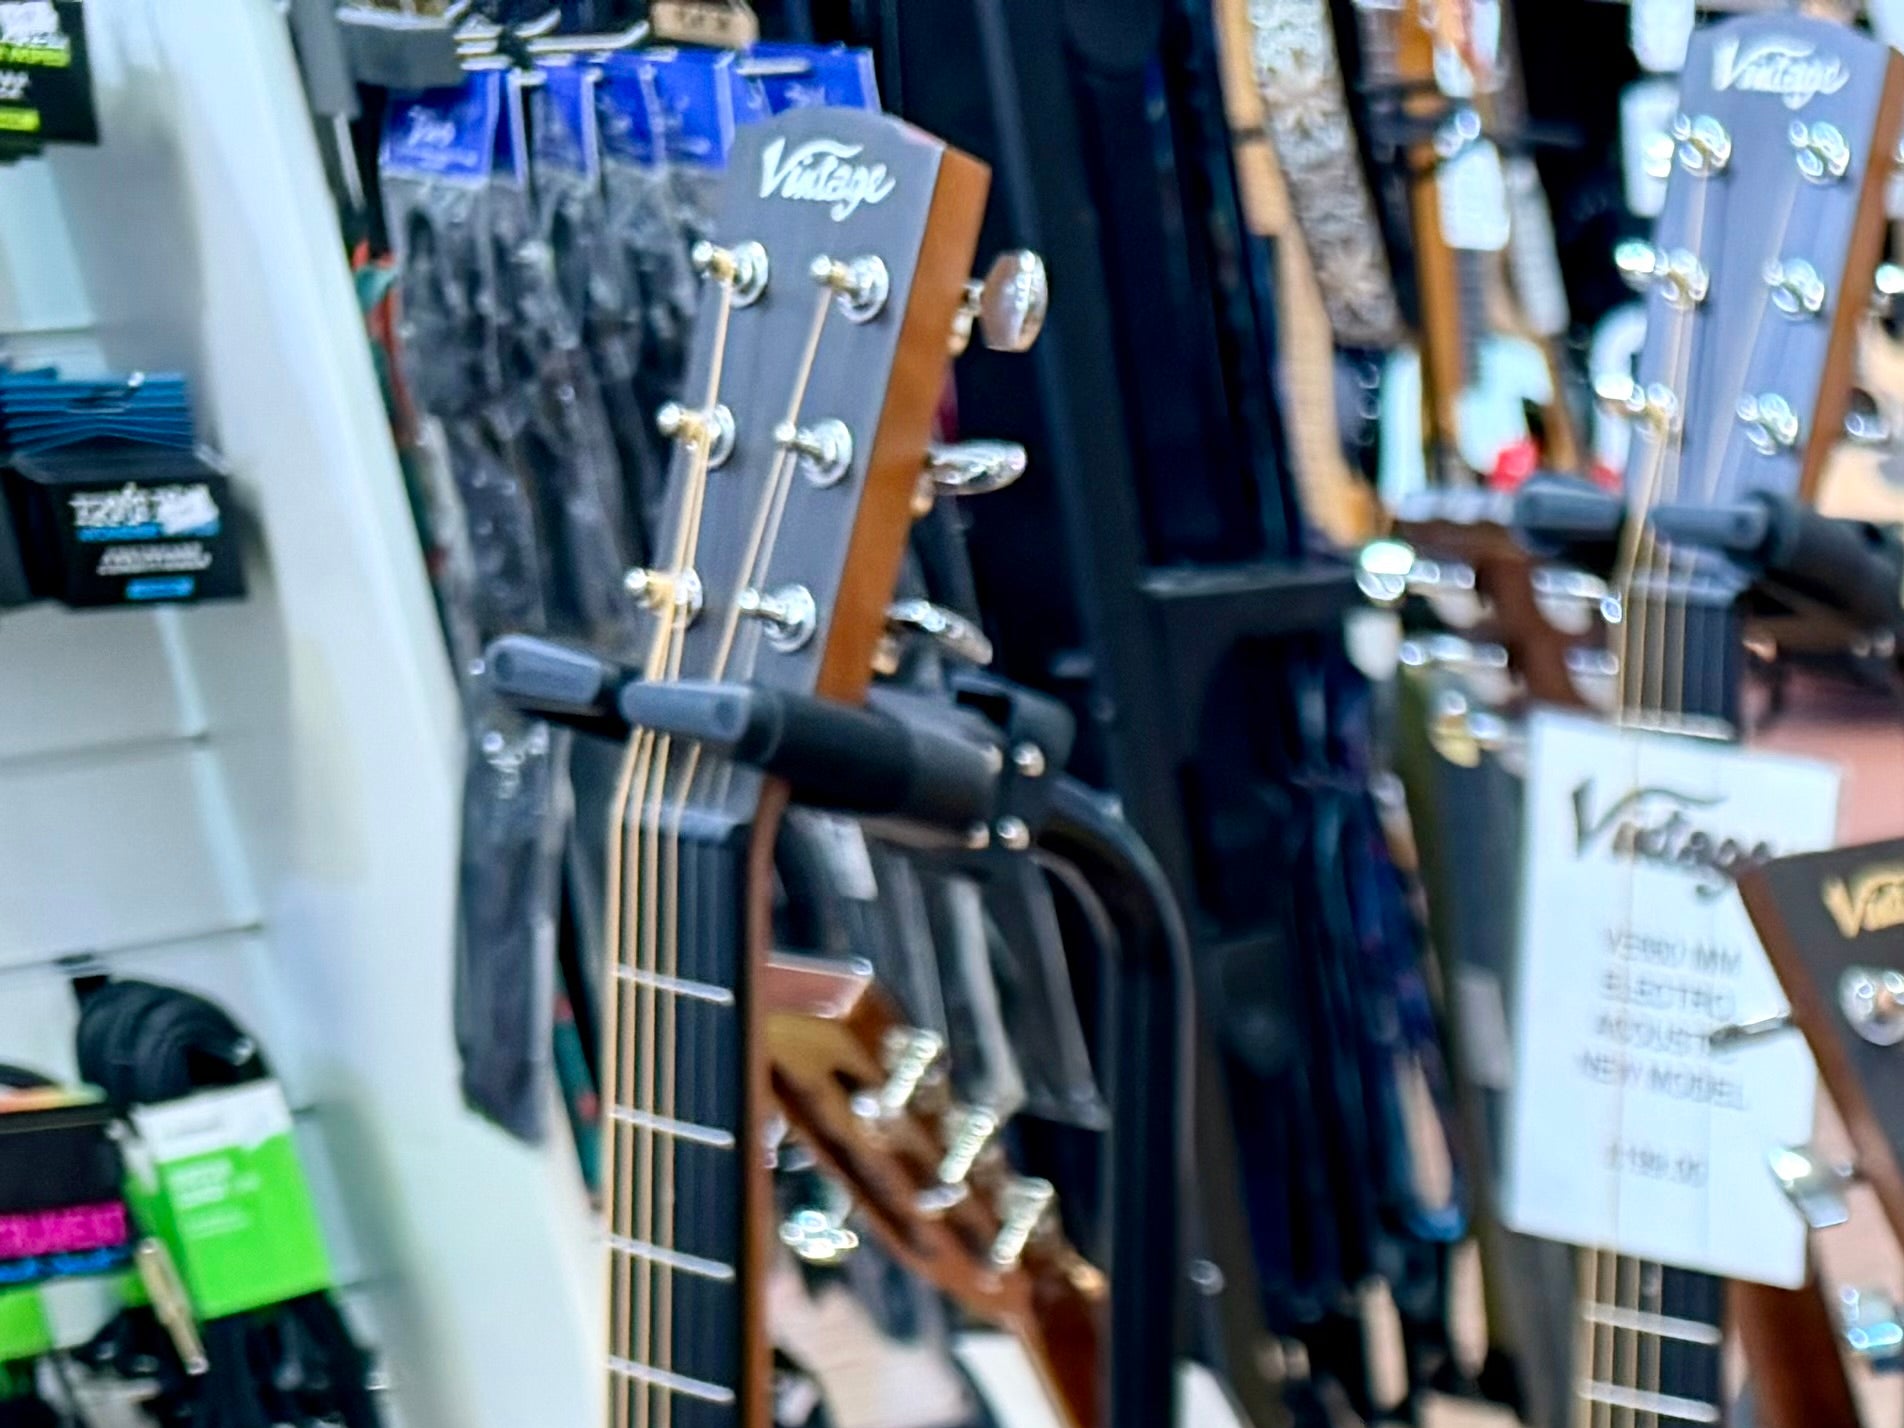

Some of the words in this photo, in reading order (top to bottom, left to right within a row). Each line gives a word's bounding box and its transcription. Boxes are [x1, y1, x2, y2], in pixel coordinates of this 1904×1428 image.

[1711, 35, 1850, 110] Vintage
[760, 136, 896, 222] Vintage
[1600, 969, 1737, 1021] ELECTRO
[1595, 1008, 1738, 1064] ACOUST
[1575, 1047, 1643, 1086] NEW
[1648, 1060, 1746, 1111] MODEL
